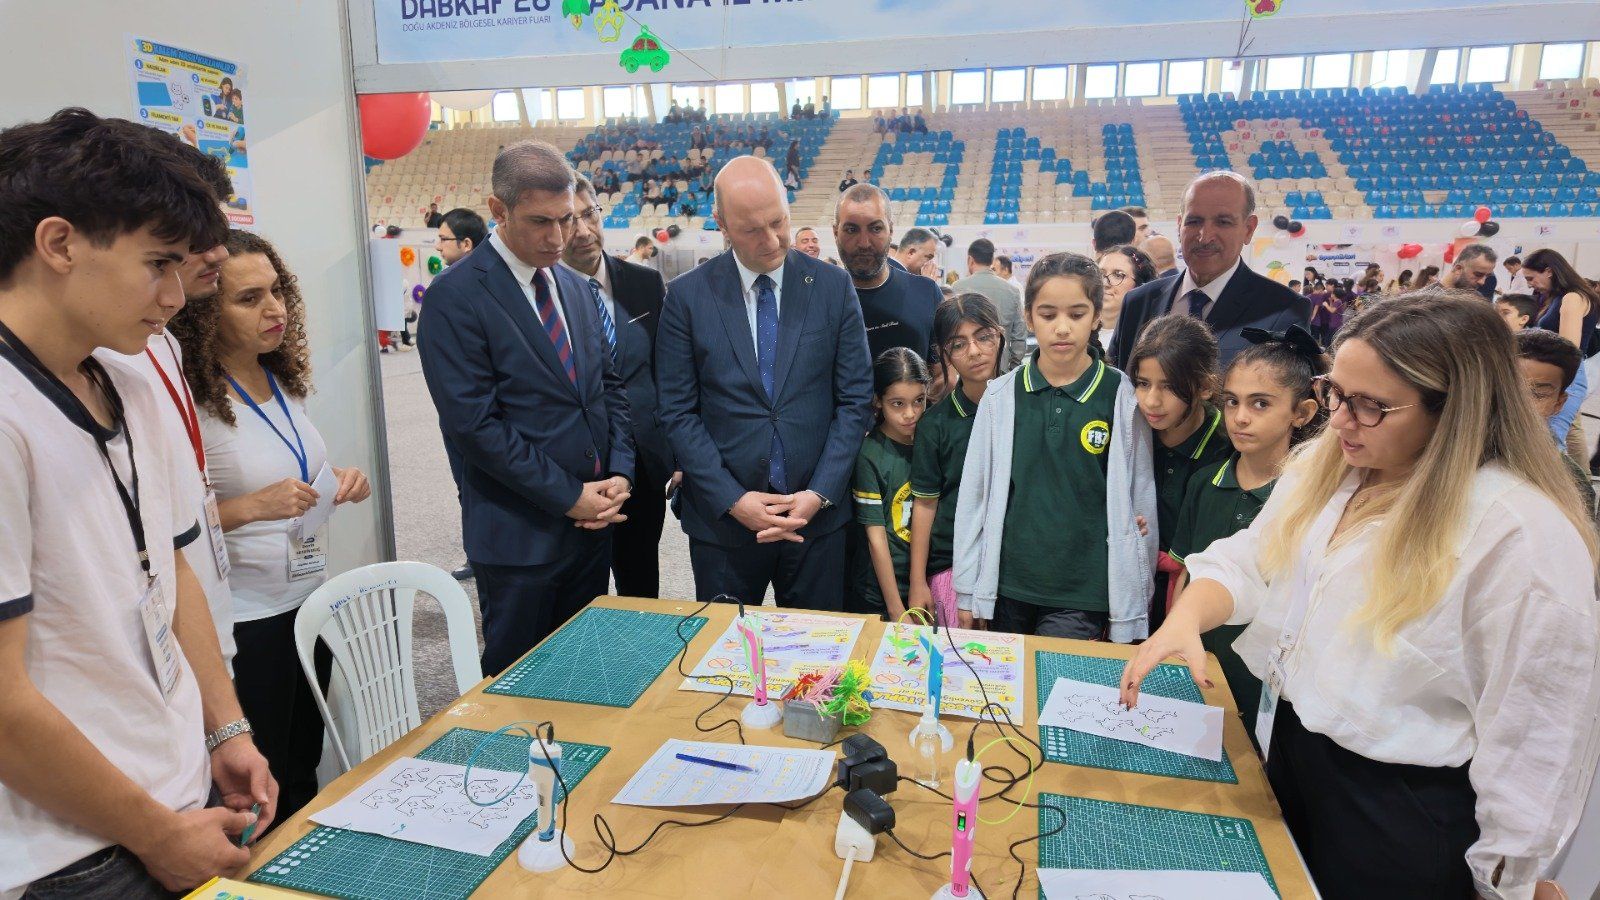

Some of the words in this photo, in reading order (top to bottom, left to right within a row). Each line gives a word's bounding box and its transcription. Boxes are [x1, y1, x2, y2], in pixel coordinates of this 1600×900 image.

[402, 22, 425, 32] DOĞU
[426, 20, 458, 31] AKDENİZ
[459, 18, 496, 29] BÖLGESEL
[529, 14, 552, 25] FUARI
[141, 41, 154, 53] 3D
